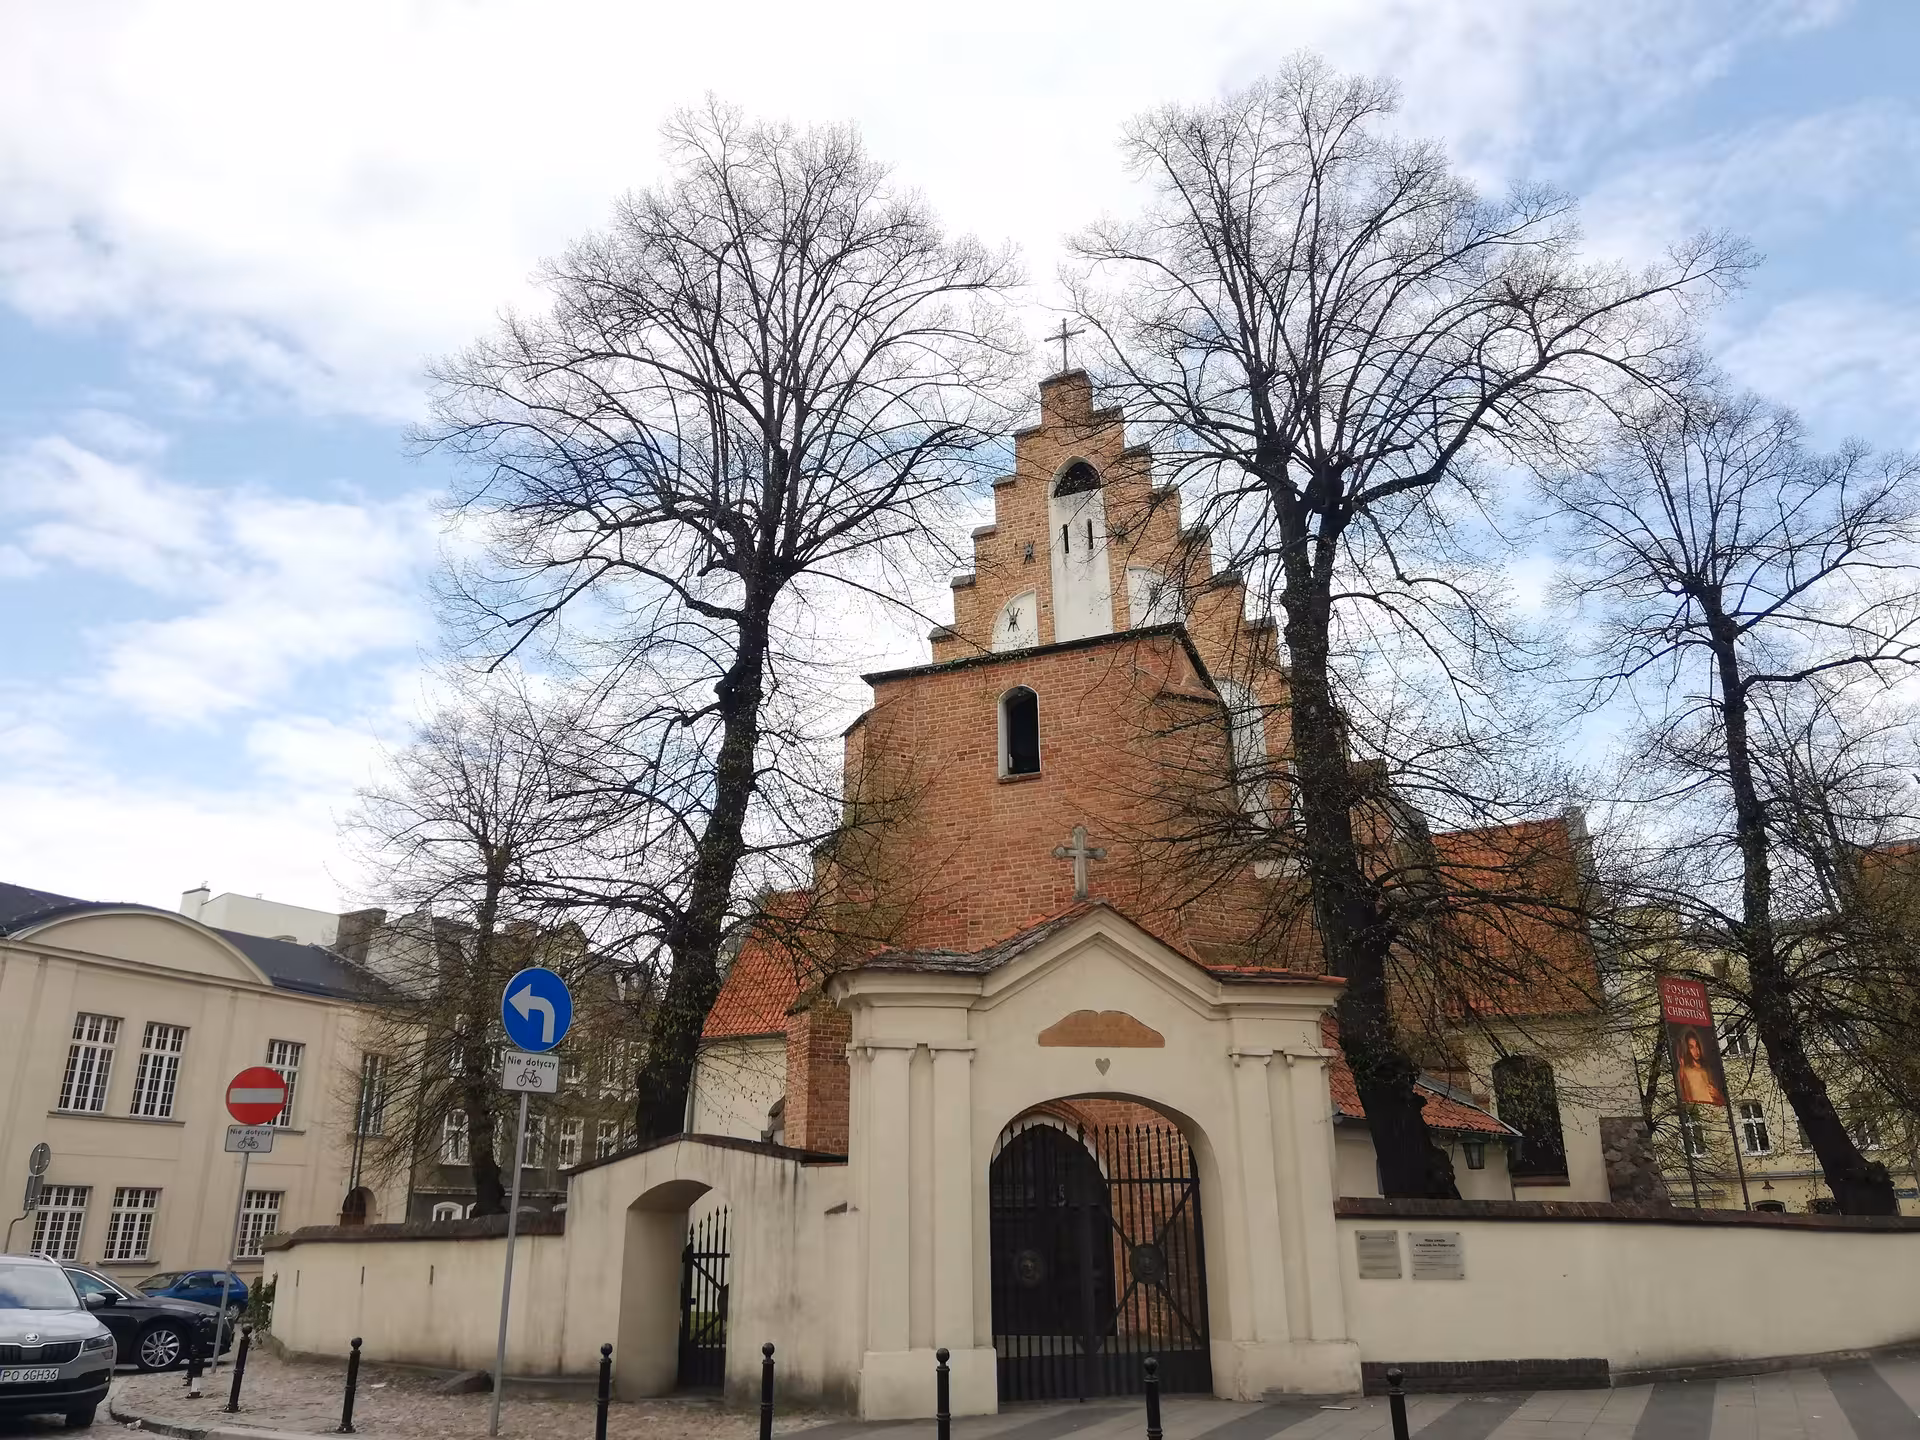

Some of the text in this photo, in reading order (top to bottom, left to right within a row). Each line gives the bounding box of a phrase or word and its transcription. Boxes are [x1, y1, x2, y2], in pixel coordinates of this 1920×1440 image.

[1665, 995, 1672, 1004] W
[1667, 1006, 1707, 1020] CHRYSTUSA
[507, 1056, 556, 1070] Nie dotyczy
[2, 1369, 57, 1381] PO 6GH36
